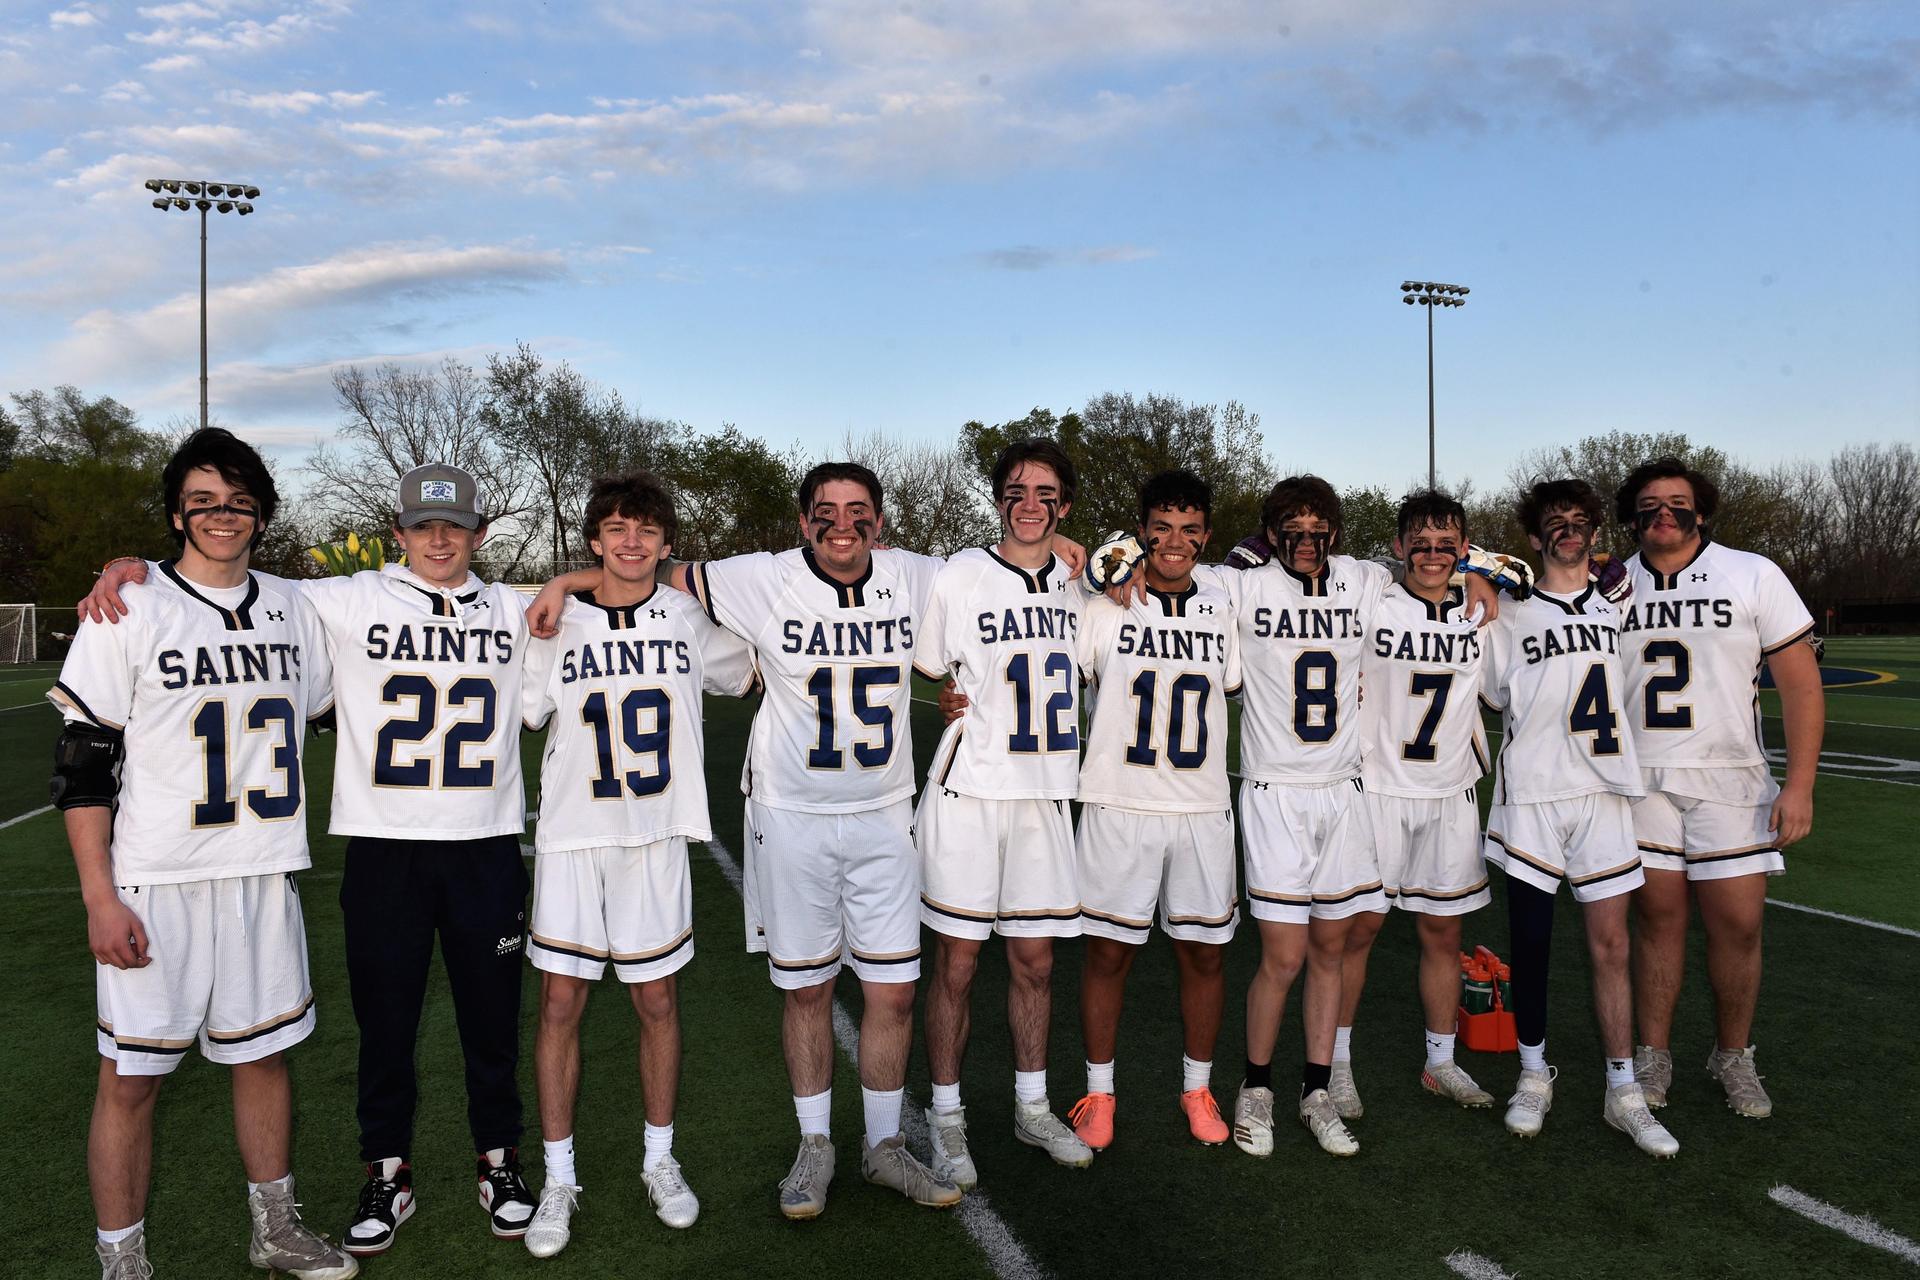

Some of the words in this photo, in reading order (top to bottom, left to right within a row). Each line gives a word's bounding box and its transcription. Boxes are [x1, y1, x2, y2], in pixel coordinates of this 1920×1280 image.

[366, 623, 513, 664] SAINTS
[560, 639, 691, 684] SAINTS
[781, 615, 914, 656] SAINTS
[977, 606, 1077, 645] SAINTS
[1117, 623, 1225, 664] SAINTS
[1254, 607, 1363, 639] SAINTS
[1521, 623, 1621, 665] SAINT
[1620, 598, 1733, 633] AINTS
[805, 662, 903, 771] 15
[1003, 650, 1081, 755] 12
[1122, 667, 1213, 771] 10
[1290, 647, 1341, 745] 8
[1400, 670, 1456, 762] 7
[1567, 660, 1623, 757] 4
[1641, 637, 1694, 730] 2
[190, 693, 302, 829] 13
[372, 671, 499, 791] 22
[579, 685, 674, 801] 19
